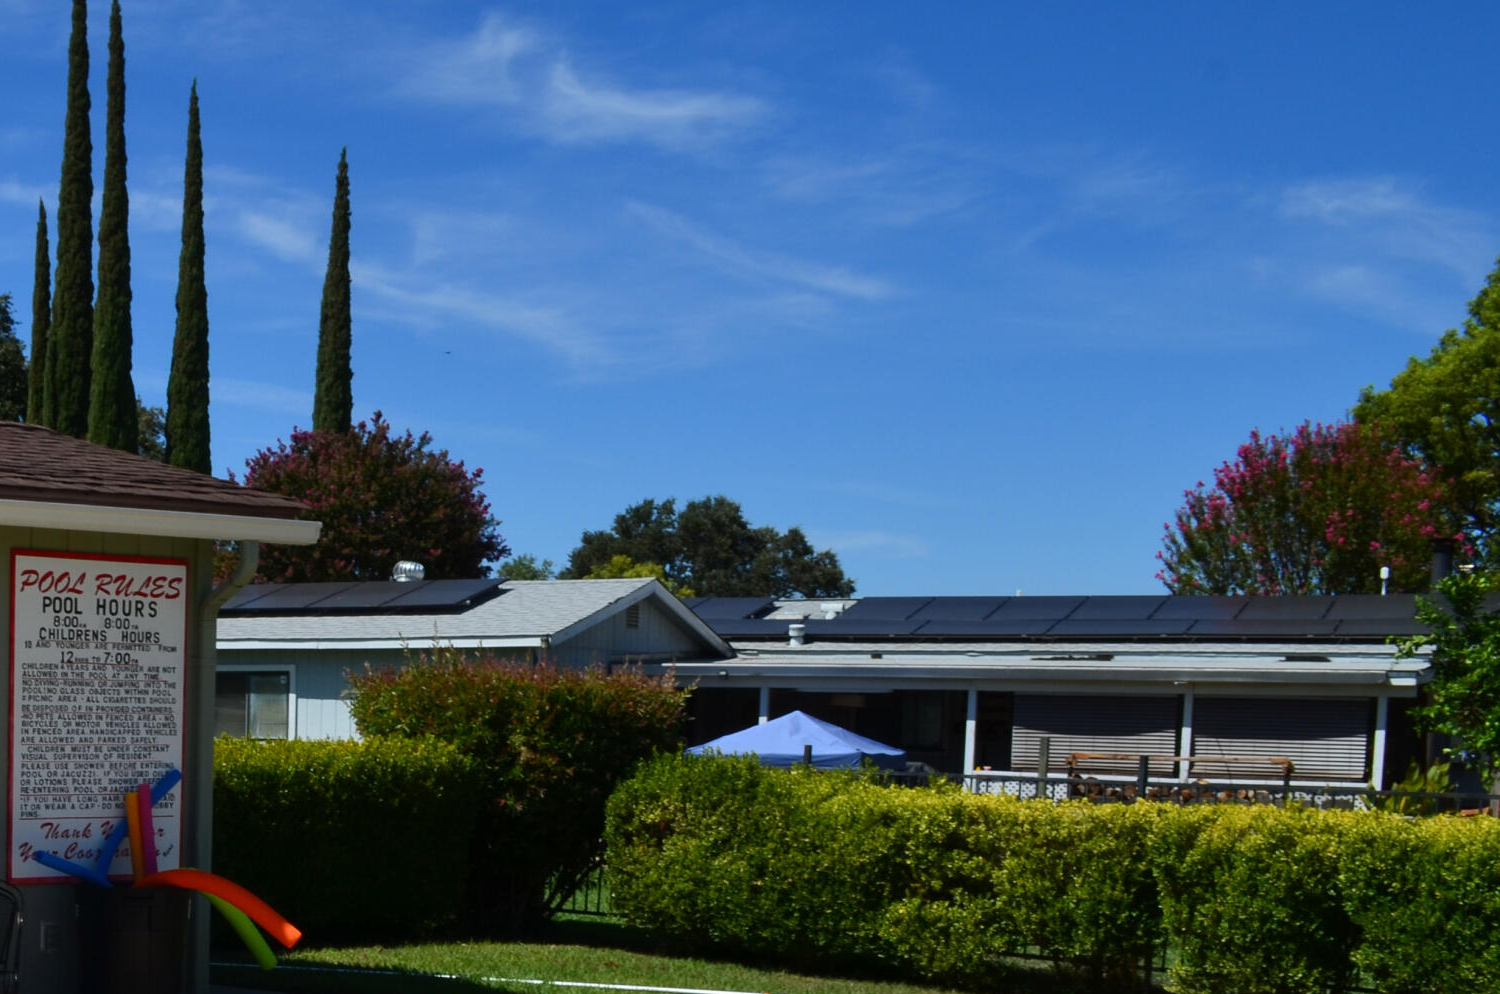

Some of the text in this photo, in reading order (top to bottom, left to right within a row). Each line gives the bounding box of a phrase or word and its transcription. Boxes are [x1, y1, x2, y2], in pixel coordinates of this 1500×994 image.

[20, 569, 183, 599] POOL RULES
[42, 596, 158, 618] POOL HOURS
[39, 627, 160, 643] CHILDRENS HOURS
[40, 822, 92, 839] Thank
